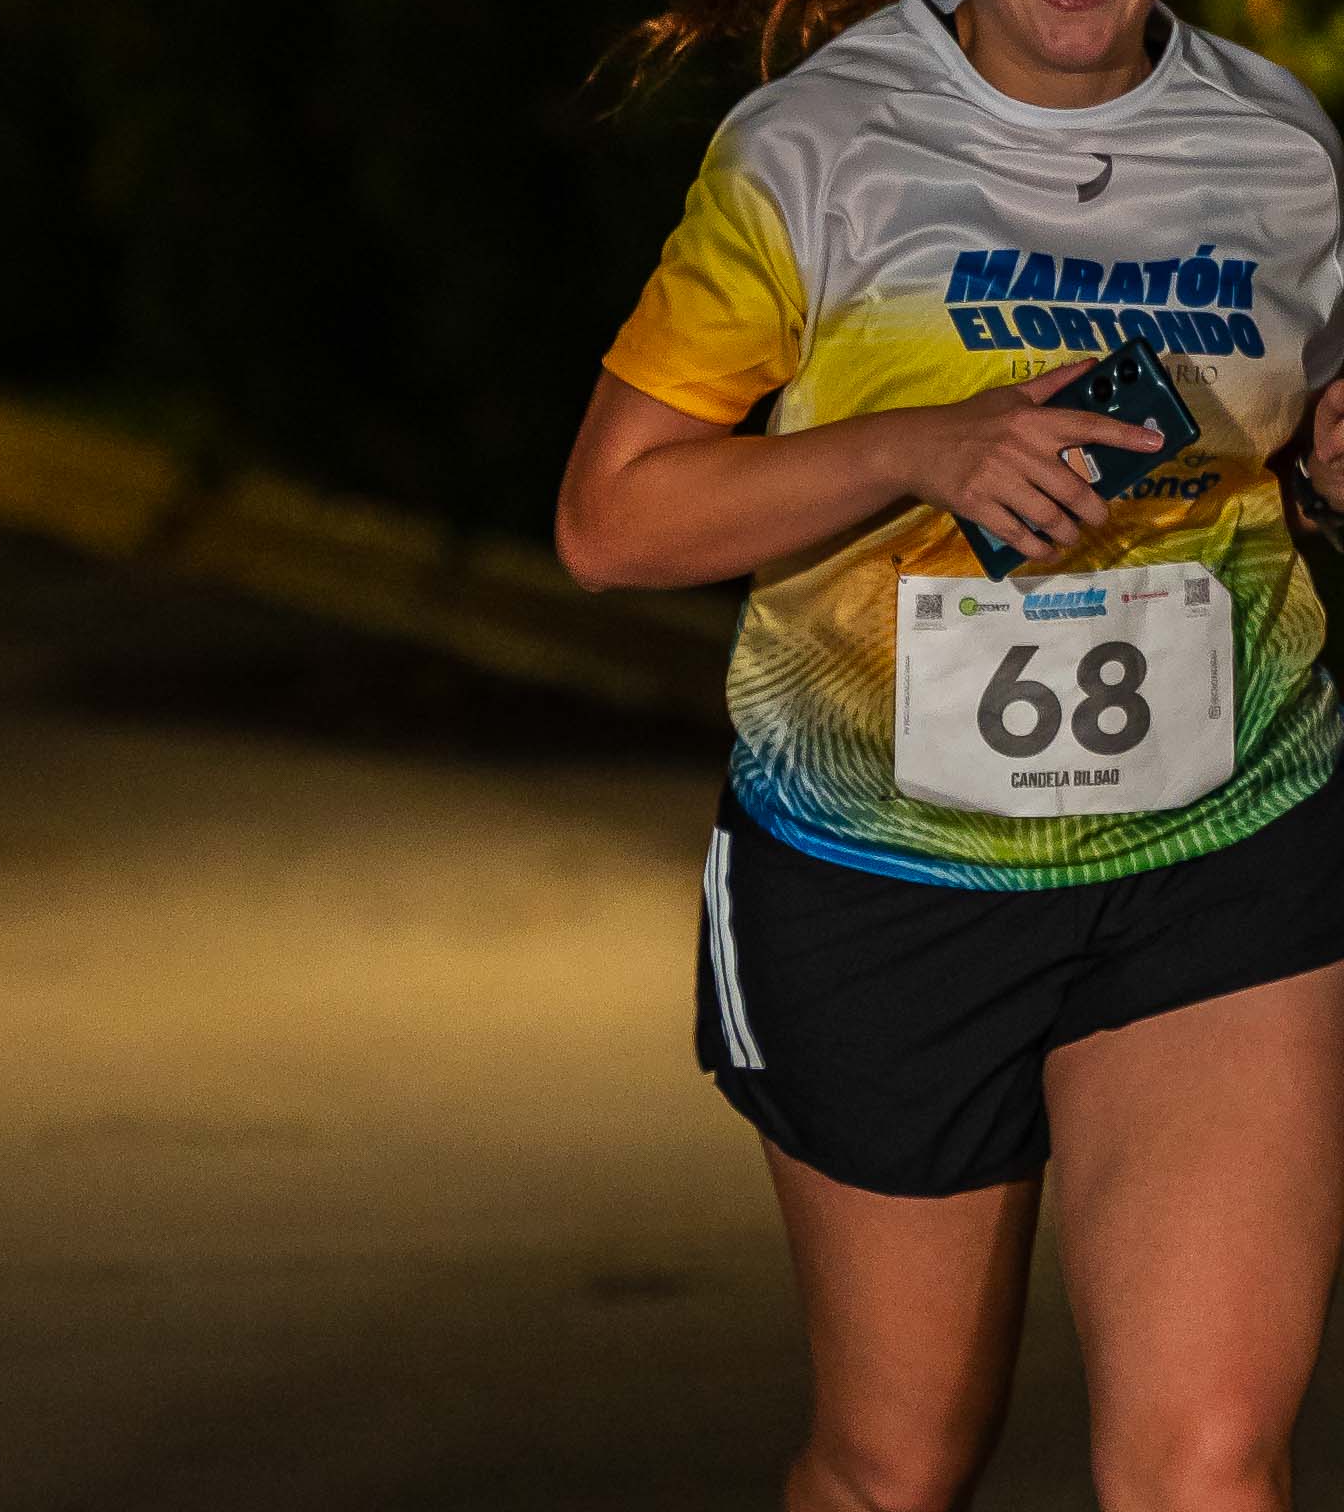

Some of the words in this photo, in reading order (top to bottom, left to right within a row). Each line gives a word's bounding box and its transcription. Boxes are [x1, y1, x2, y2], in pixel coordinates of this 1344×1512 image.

[945, 245, 1258, 310] MARATÓN
[948, 305, 1264, 359] ELORTONDO
[977, 641, 1151, 759] 68
[1011, 771, 1070, 788] CANDELA
